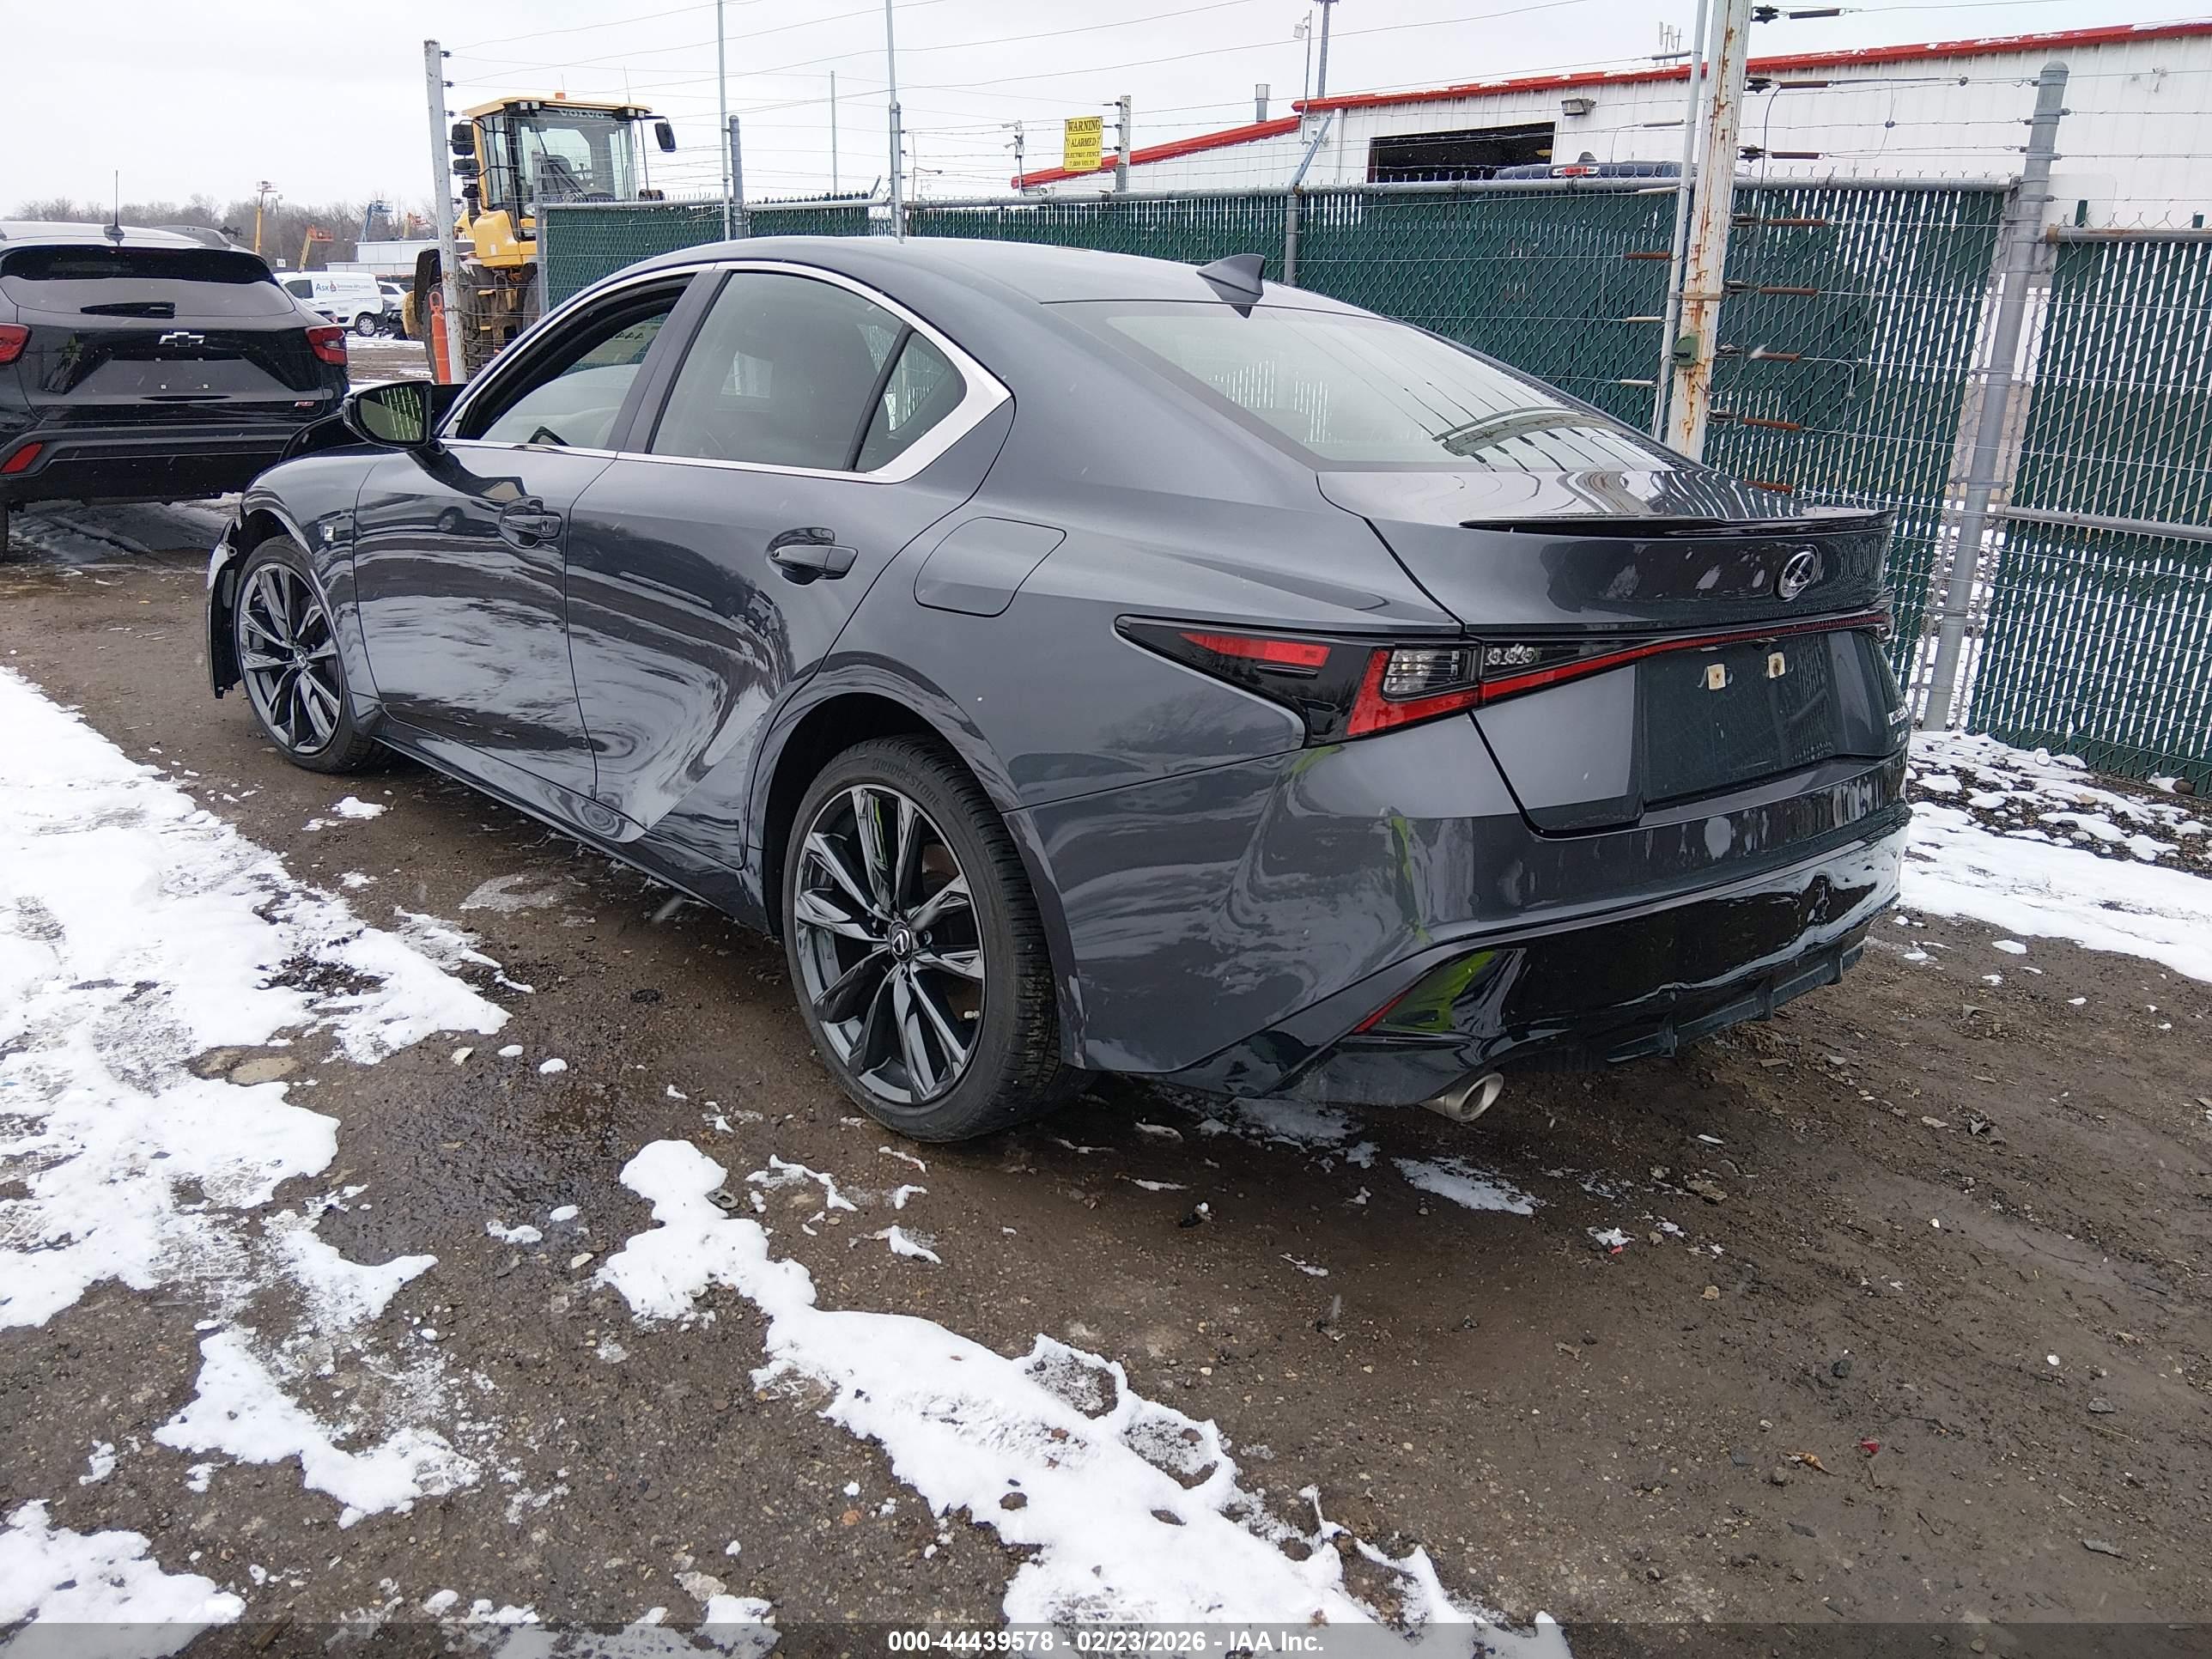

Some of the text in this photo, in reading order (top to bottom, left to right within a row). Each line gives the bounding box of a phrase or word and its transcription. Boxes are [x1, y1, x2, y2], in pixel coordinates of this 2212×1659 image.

[560, 110, 605, 118] VOLVO
[1067, 120, 1100, 132] WARNING
[1071, 137, 1096, 147] ALARMED
